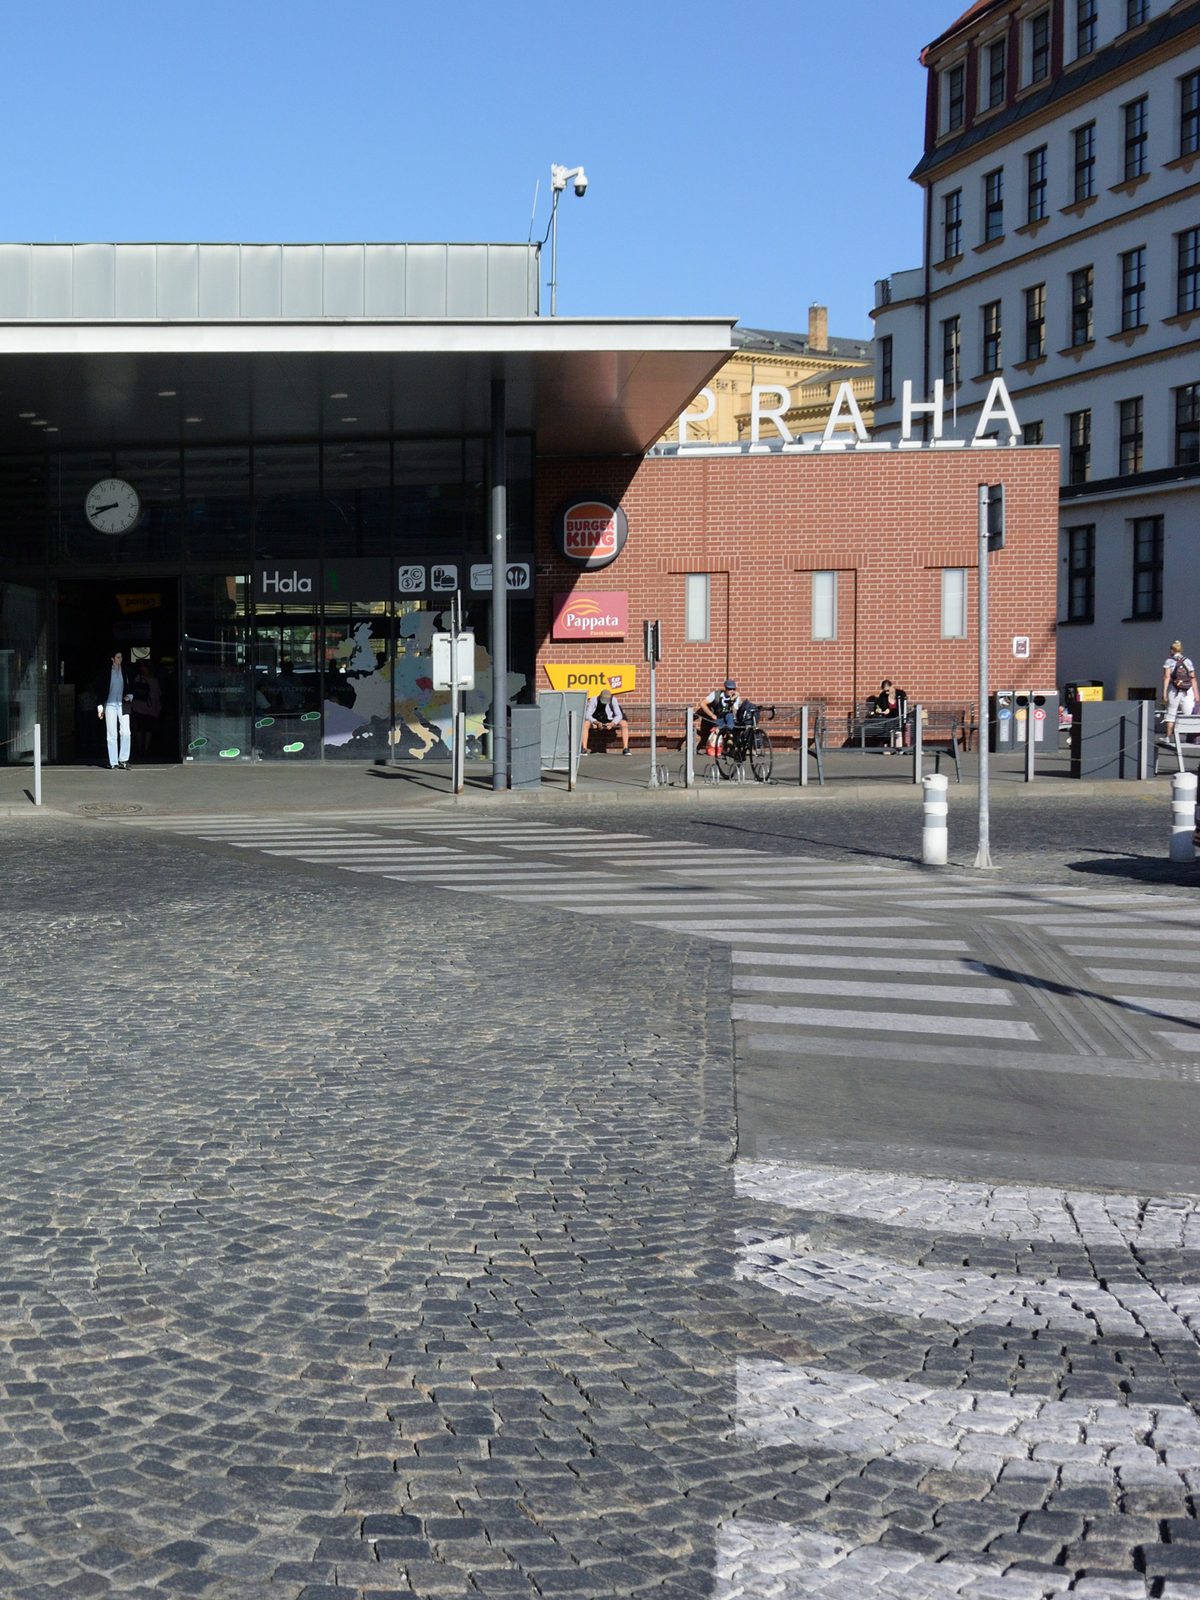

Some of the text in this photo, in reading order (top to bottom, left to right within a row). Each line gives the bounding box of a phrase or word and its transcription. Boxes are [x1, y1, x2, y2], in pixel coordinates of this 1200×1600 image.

[678, 377, 1022, 444] PRAHA
[566, 520, 615, 531] BURGER
[566, 531, 615, 547] KING
[262, 570, 311, 593] Hala
[566, 613, 619, 630] Pappata
[567, 672, 606, 688] pont
